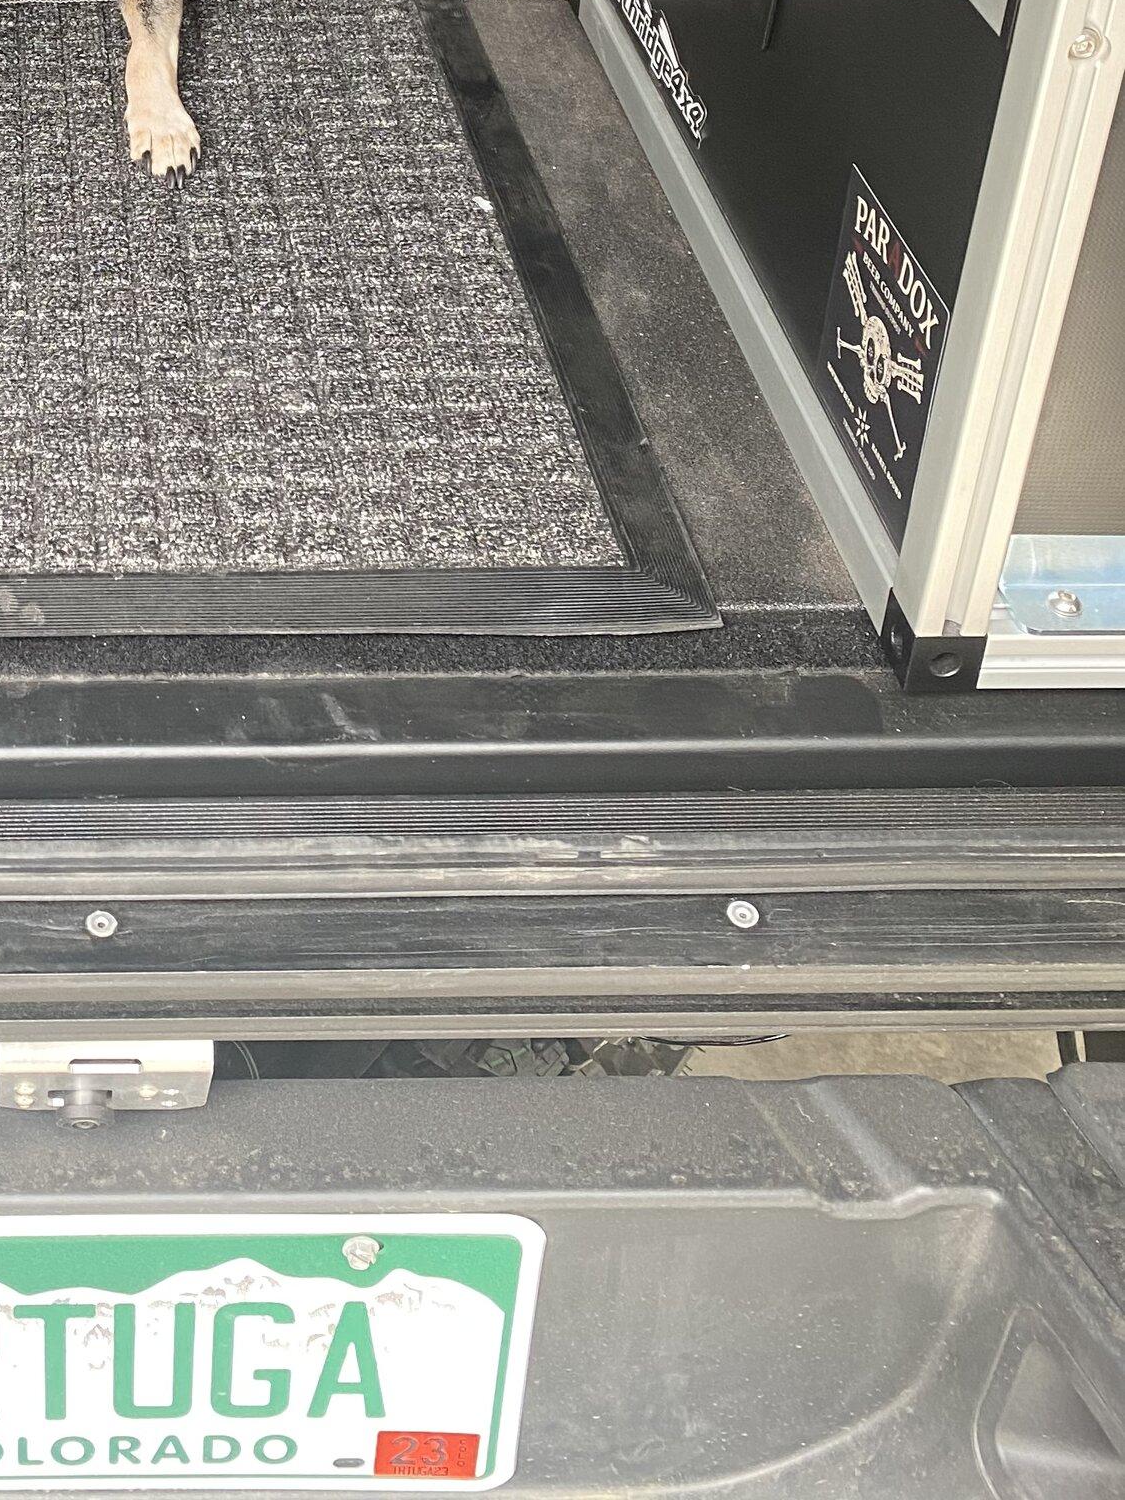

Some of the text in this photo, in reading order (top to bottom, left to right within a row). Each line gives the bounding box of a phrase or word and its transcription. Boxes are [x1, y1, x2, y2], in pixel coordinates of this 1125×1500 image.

[854, 195, 940, 350] PARADOX
[863, 251, 881, 285] BEER
[880, 280, 914, 339] COMPANY
[390, 1436, 449, 1466] 23
